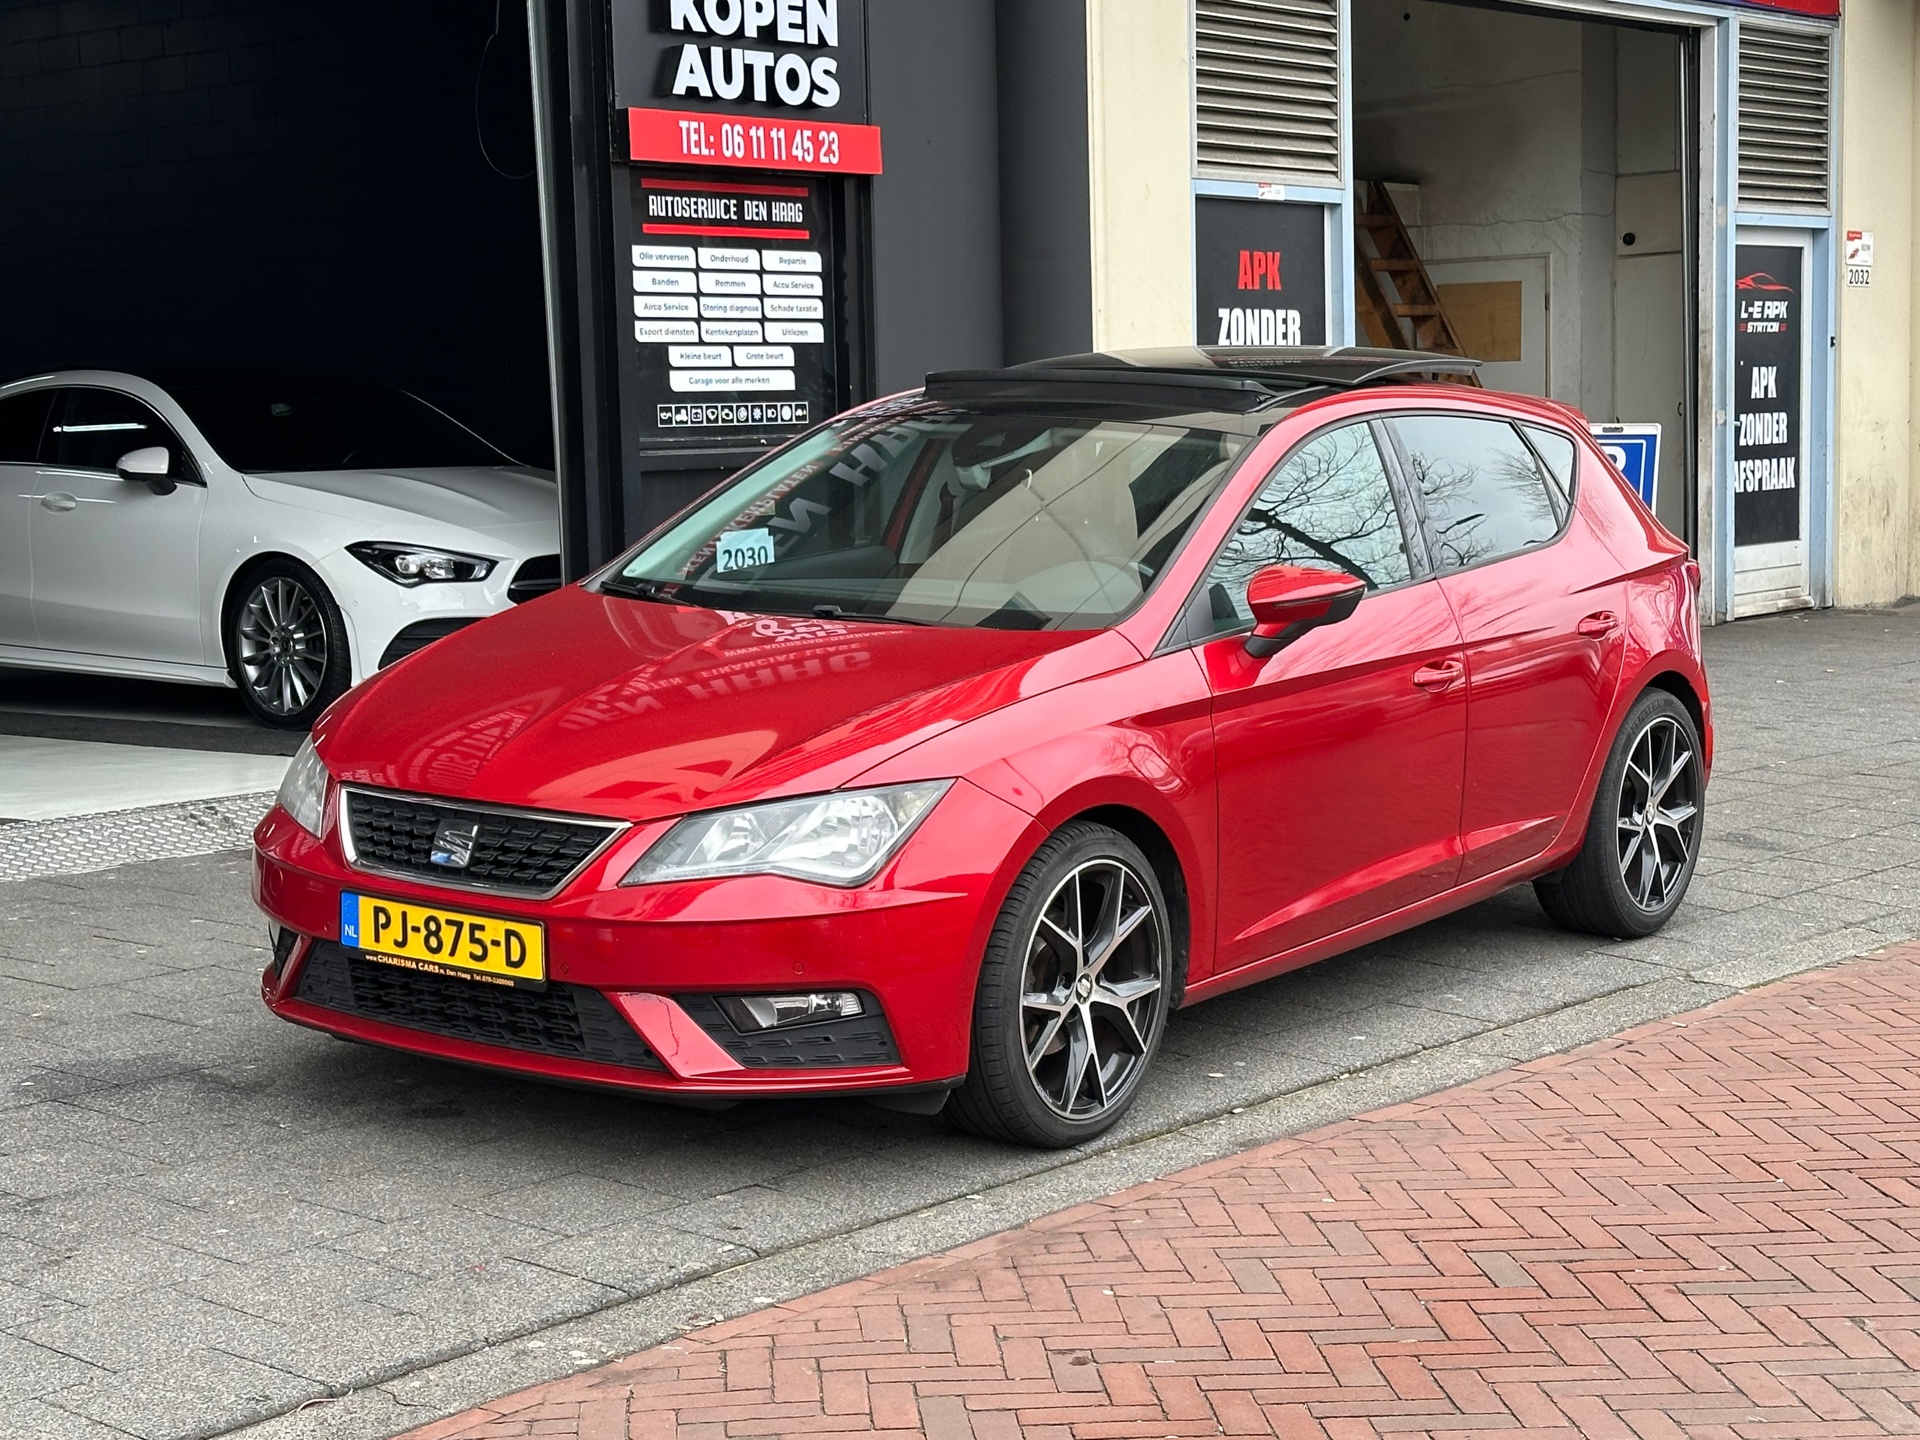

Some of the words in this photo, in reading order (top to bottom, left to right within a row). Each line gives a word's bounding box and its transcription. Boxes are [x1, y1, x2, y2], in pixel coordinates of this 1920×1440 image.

[670, 0, 839, 47] KOPEN
[672, 43, 841, 108] AUTOS
[679, 119, 715, 157] TEL:
[721, 123, 744, 159] 06
[749, 125, 765, 160] 11
[770, 127, 787, 162] 11
[792, 129, 814, 163] 45
[818, 131, 840, 165] 23
[648, 194, 737, 220] AUTOSERVICE
[744, 200, 767, 222] DEN
[772, 202, 803, 223] HAAG
[639, 252, 654, 261] Olie
[710, 254, 749, 264] Onderhoud
[1237, 249, 1282, 291] APK
[651, 277, 680, 287] Banden
[1848, 268, 1870, 285] 2032
[715, 279, 746, 288] Remmen
[772, 281, 789, 289] Accu
[790, 281, 815, 290] Service
[643, 303, 662, 311] Airco
[663, 303, 689, 312] Service
[702, 303, 728, 313] Storing
[729, 303, 760, 314] diagnose
[770, 304, 794, 312] Schade
[1763, 300, 1789, 319] APK
[639, 327, 663, 337] Export
[664, 327, 695, 336] diensten
[1217, 307, 1301, 346] ZONDER
[1746, 321, 1780, 333] STATION
[705, 328, 759, 338] Kentekenplaten
[703, 351, 722, 360] beurt
[745, 351, 764, 360] Grote
[765, 351, 784, 360] beurt
[688, 376, 714, 386] Garage
[714, 377, 730, 385] voor
[731, 376, 744, 384] alle
[744, 376, 770, 385] merken
[1750, 366, 1778, 400] APK
[1739, 411, 1788, 447] ZONDER
[721, 545, 769, 571] 2030
[344, 923, 358, 938] NL
[372, 904, 528, 969] PJ-875-D
